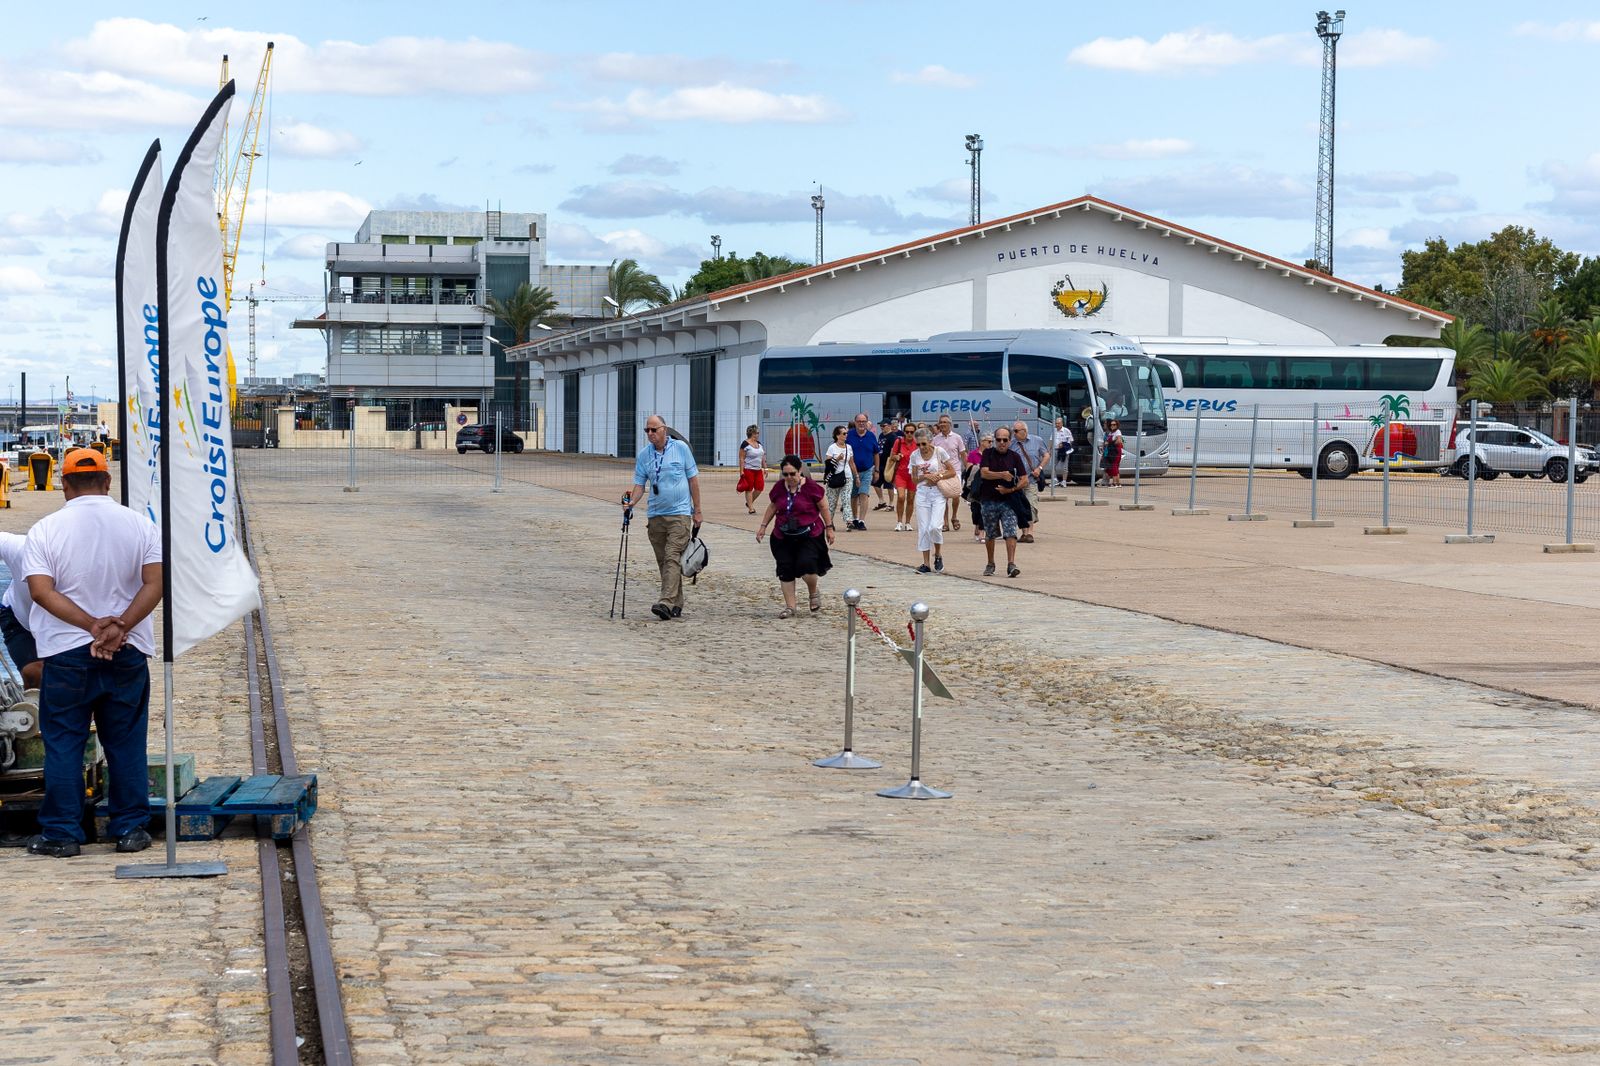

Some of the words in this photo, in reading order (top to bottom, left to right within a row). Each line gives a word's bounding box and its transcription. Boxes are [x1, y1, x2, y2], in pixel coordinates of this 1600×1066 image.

[997, 244, 1060, 263] PUERTO
[1069, 244, 1089, 254] DE
[1097, 245, 1160, 266] HUELVA
[197, 275, 229, 554] CroisiEurope
[921, 398, 992, 413] LEPEBUS
